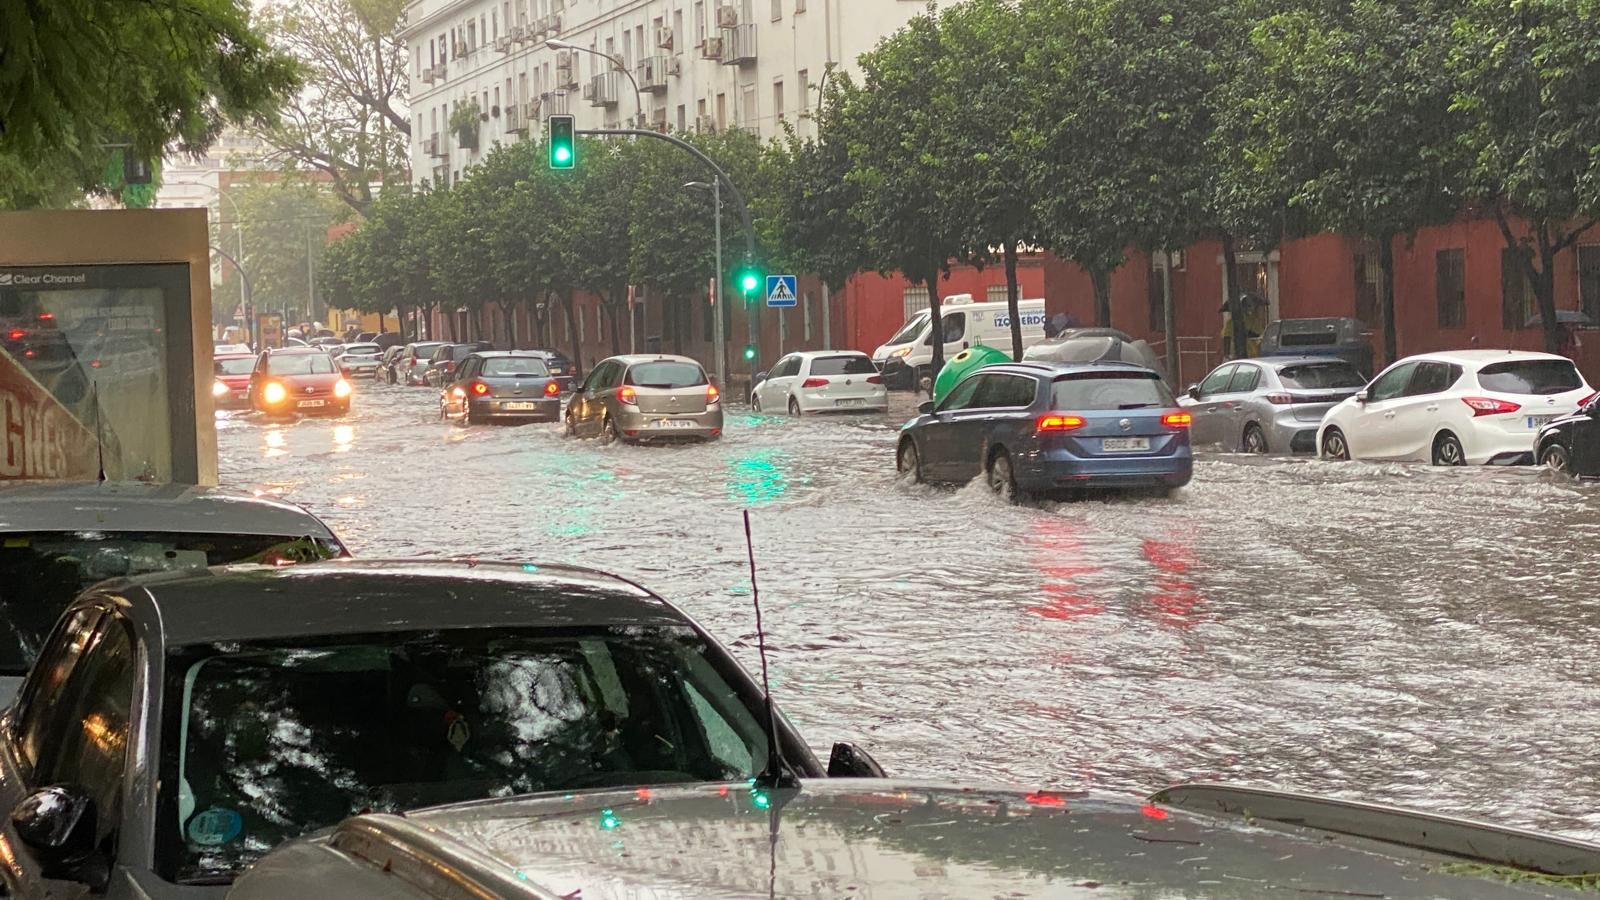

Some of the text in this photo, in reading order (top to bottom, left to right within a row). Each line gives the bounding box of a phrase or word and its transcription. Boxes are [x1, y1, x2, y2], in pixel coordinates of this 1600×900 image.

[14, 273, 86, 284] Clear Channel
[994, 315, 1046, 327] IZQERDO
